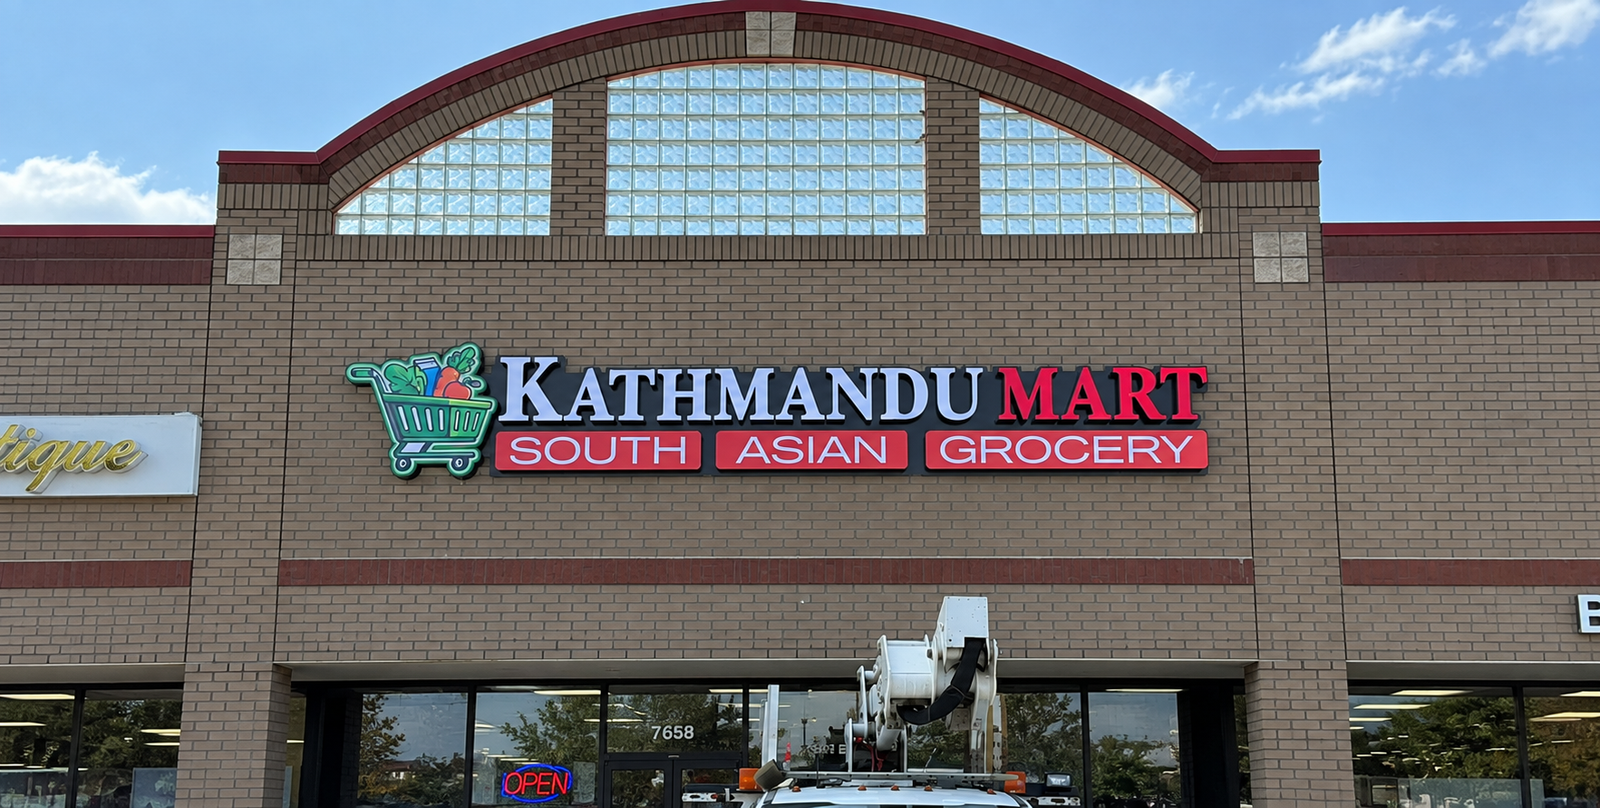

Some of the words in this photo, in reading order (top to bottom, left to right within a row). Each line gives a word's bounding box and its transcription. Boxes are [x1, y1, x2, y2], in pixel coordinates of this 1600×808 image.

[498, 355, 983, 422] KATHMANDU
[998, 366, 1208, 421] MART
[509, 435, 687, 466] SOUTH
[735, 435, 887, 465] ASIAN
[939, 435, 1194, 465] GROCERY
[651, 725, 694, 740] 7658
[504, 771, 569, 796] OPEN
